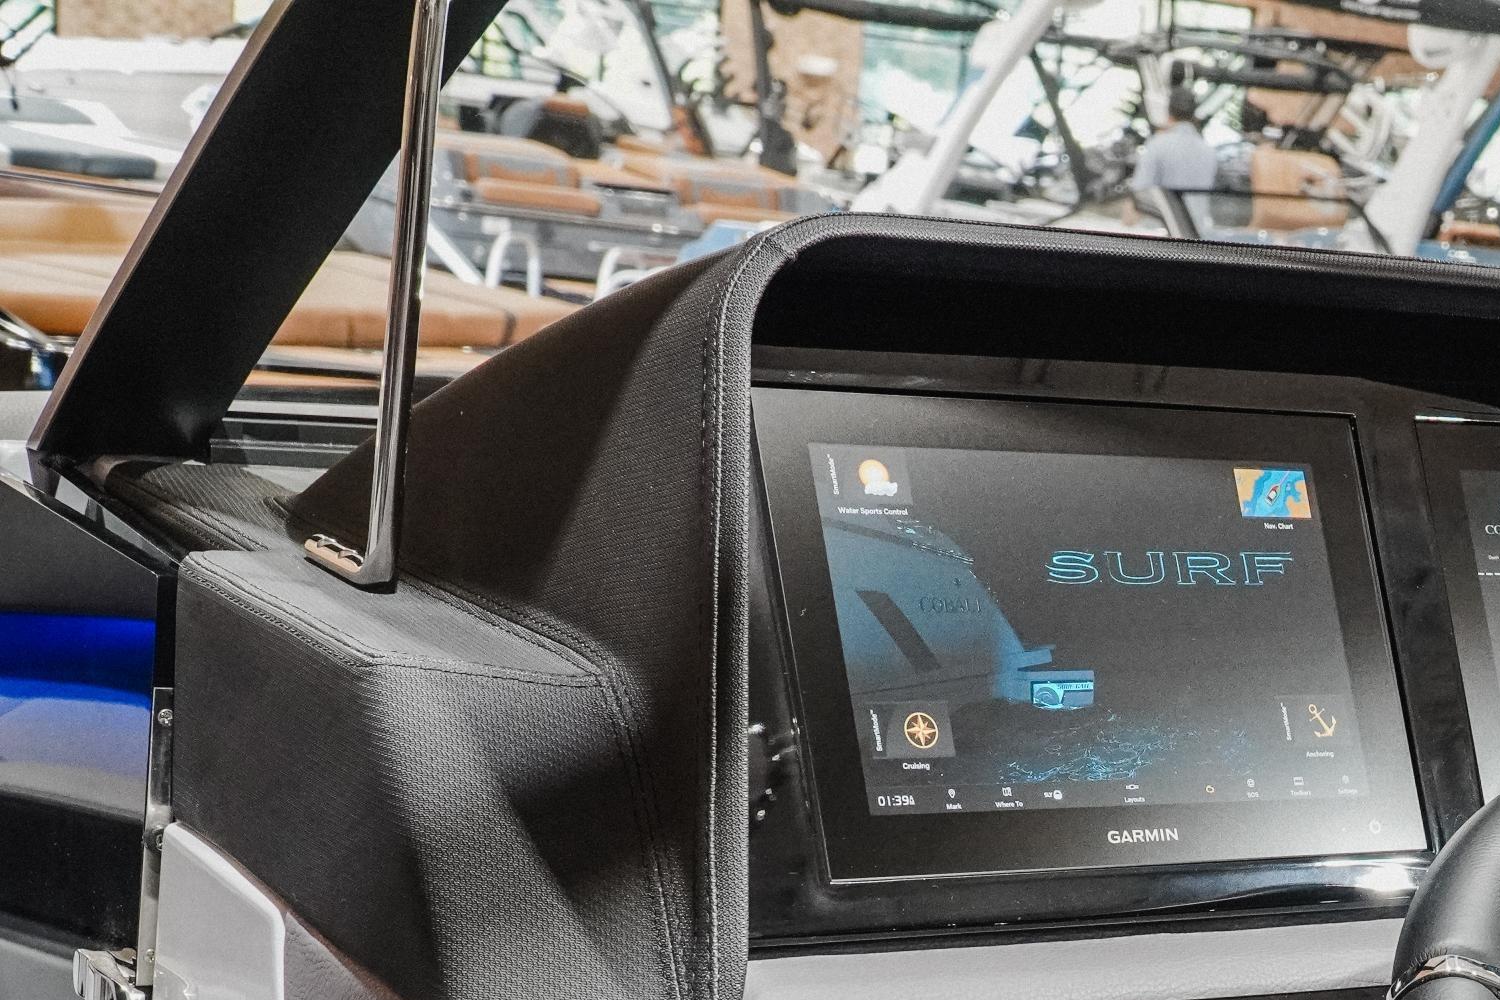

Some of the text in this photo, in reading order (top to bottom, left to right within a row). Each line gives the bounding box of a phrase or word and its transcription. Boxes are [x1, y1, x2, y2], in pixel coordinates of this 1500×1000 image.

[1045, 550, 1292, 586] SURF
[903, 762, 930, 771] Cruising
[1107, 828, 1179, 844] GARMIN
